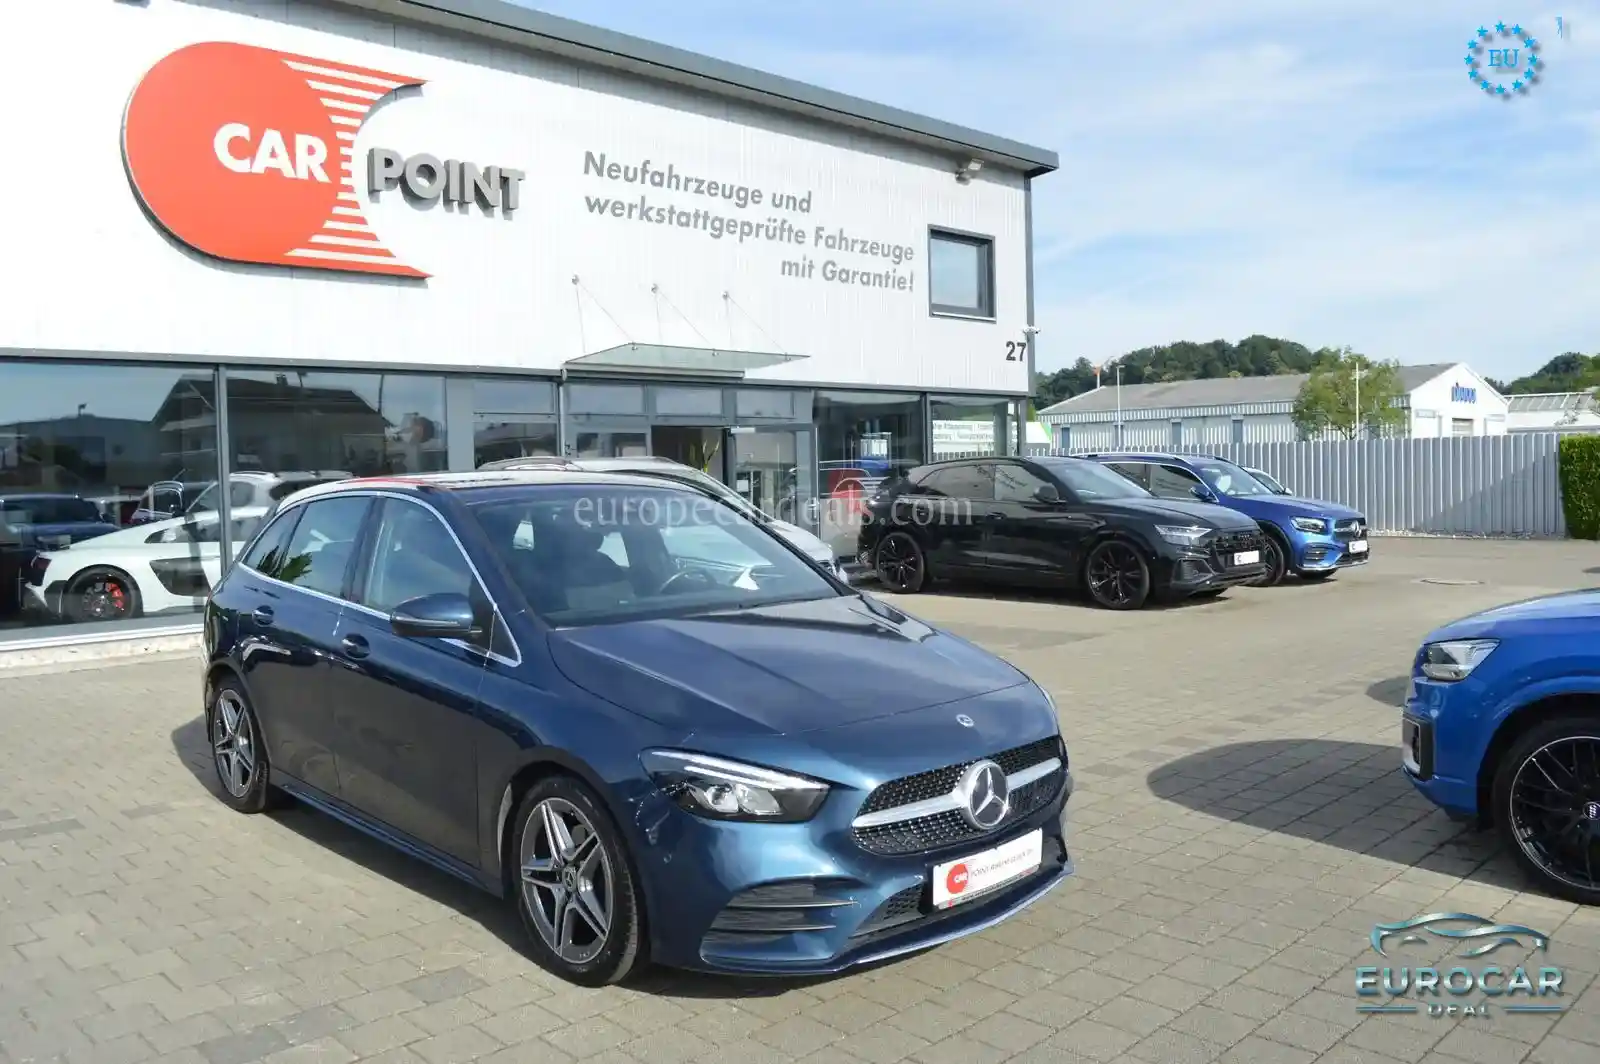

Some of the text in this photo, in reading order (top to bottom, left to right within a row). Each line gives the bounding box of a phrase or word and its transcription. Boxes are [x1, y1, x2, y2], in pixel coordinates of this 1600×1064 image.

[213, 122, 332, 184] CAR
[367, 147, 526, 215] POINT
[583, 150, 812, 213] Neufahrzeuge und
[584, 194, 915, 265] werkstattgeprüfte Fahrzeuge
[780, 255, 914, 292] mit Garantie!
[1005, 340, 1027, 362] 27
